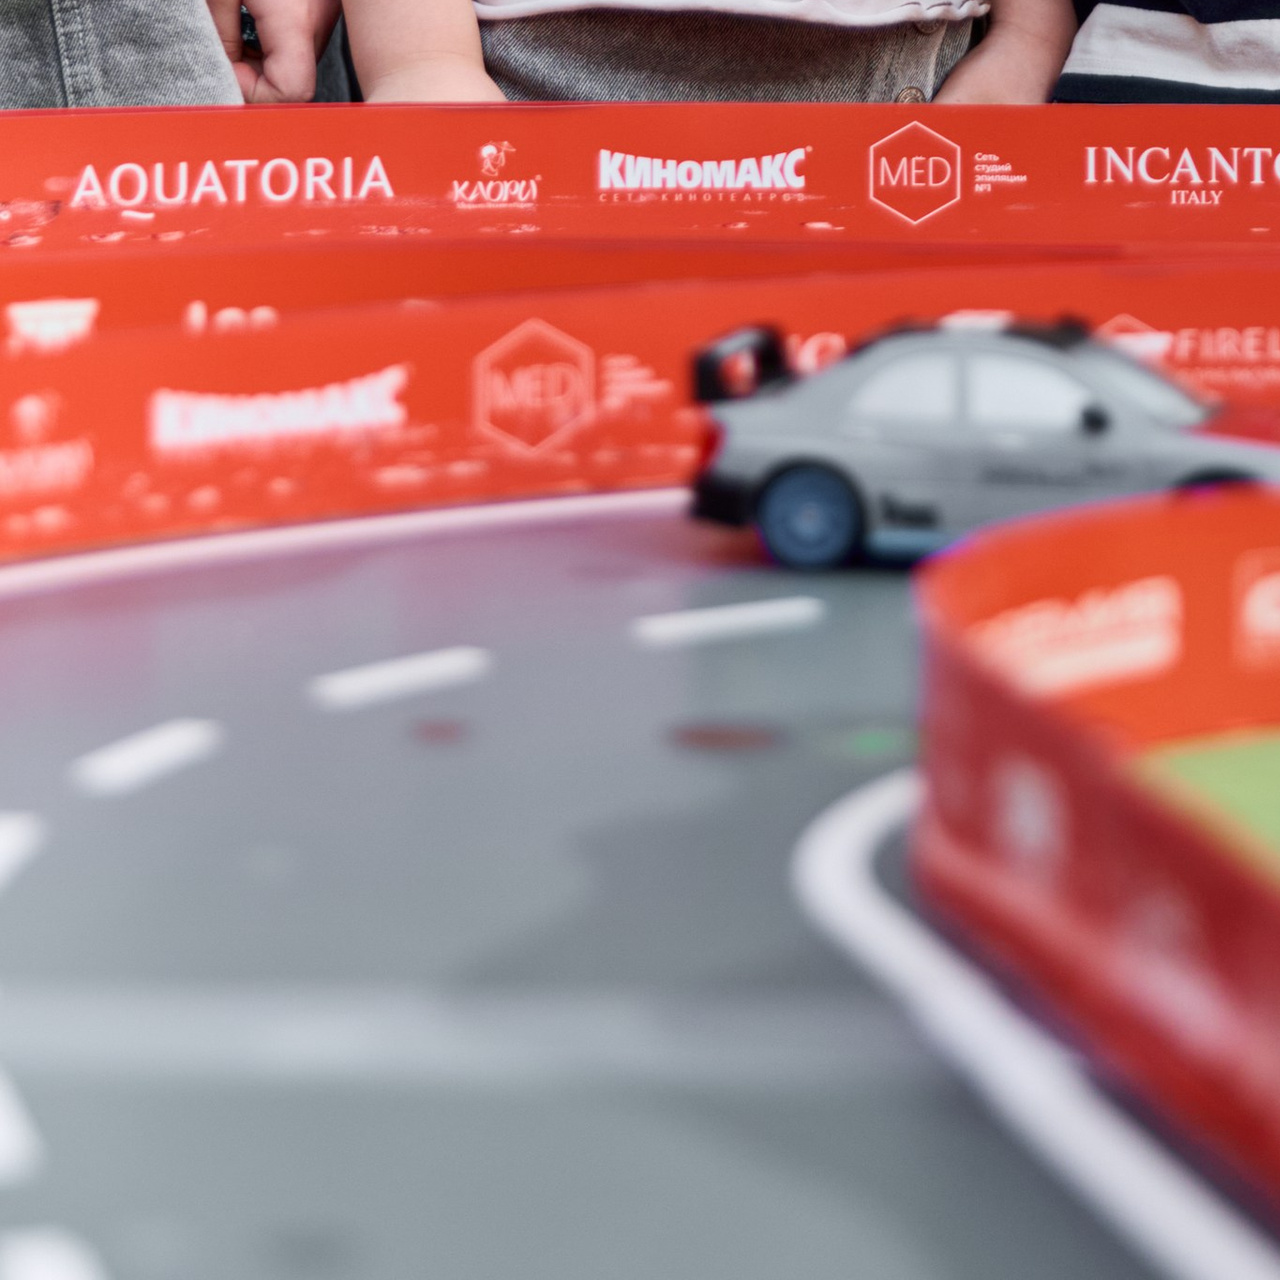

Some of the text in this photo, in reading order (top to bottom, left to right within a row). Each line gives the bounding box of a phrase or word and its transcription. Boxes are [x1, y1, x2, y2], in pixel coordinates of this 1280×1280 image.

[70, 155, 395, 218] AQUATORIA
[600, 148, 806, 190] КИНОМАКС
[1170, 190, 1223, 205] ITALY
